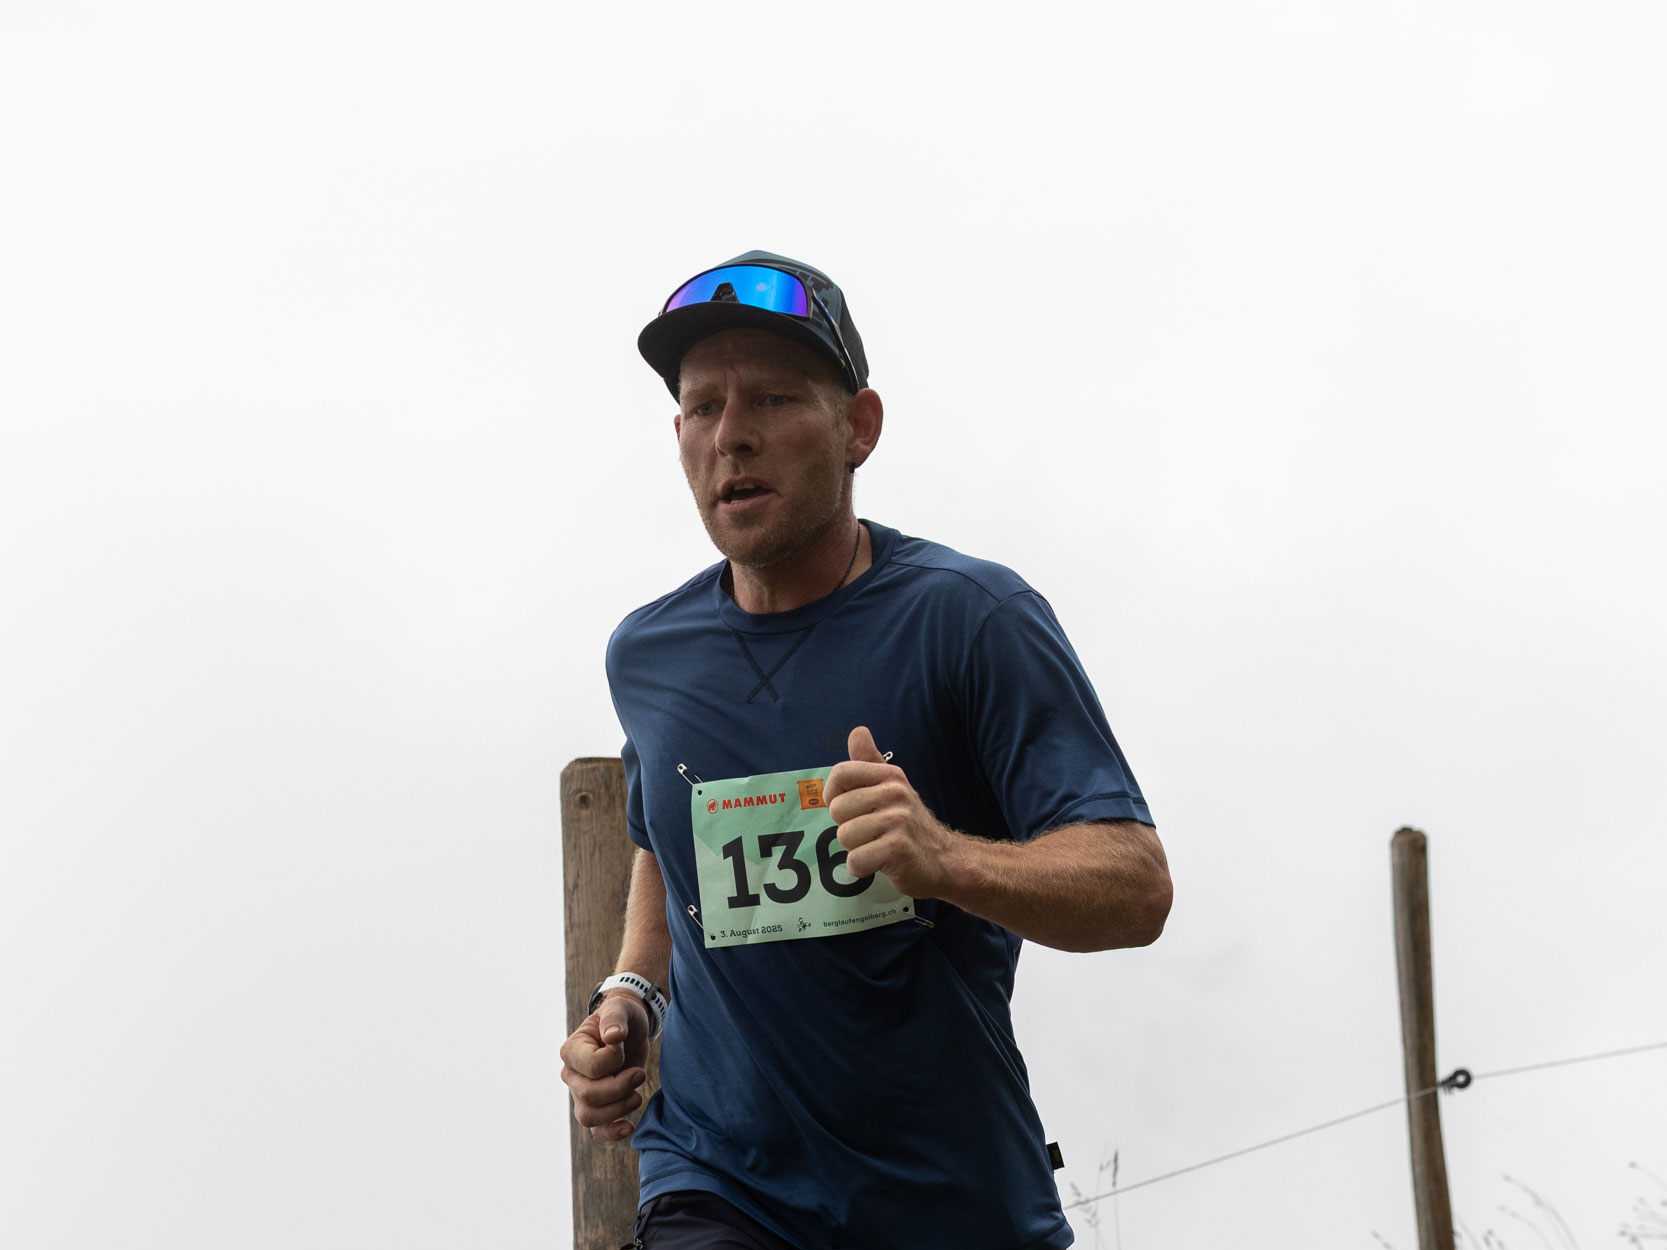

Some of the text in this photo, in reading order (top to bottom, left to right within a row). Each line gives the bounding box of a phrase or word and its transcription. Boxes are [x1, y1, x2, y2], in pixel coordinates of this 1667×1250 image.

[722, 792, 786, 810] MAMMUT
[722, 825, 875, 909] 136
[823, 908, 897, 927] berglaufengelberg.ch
[720, 924, 783, 938] 3. August 2025
